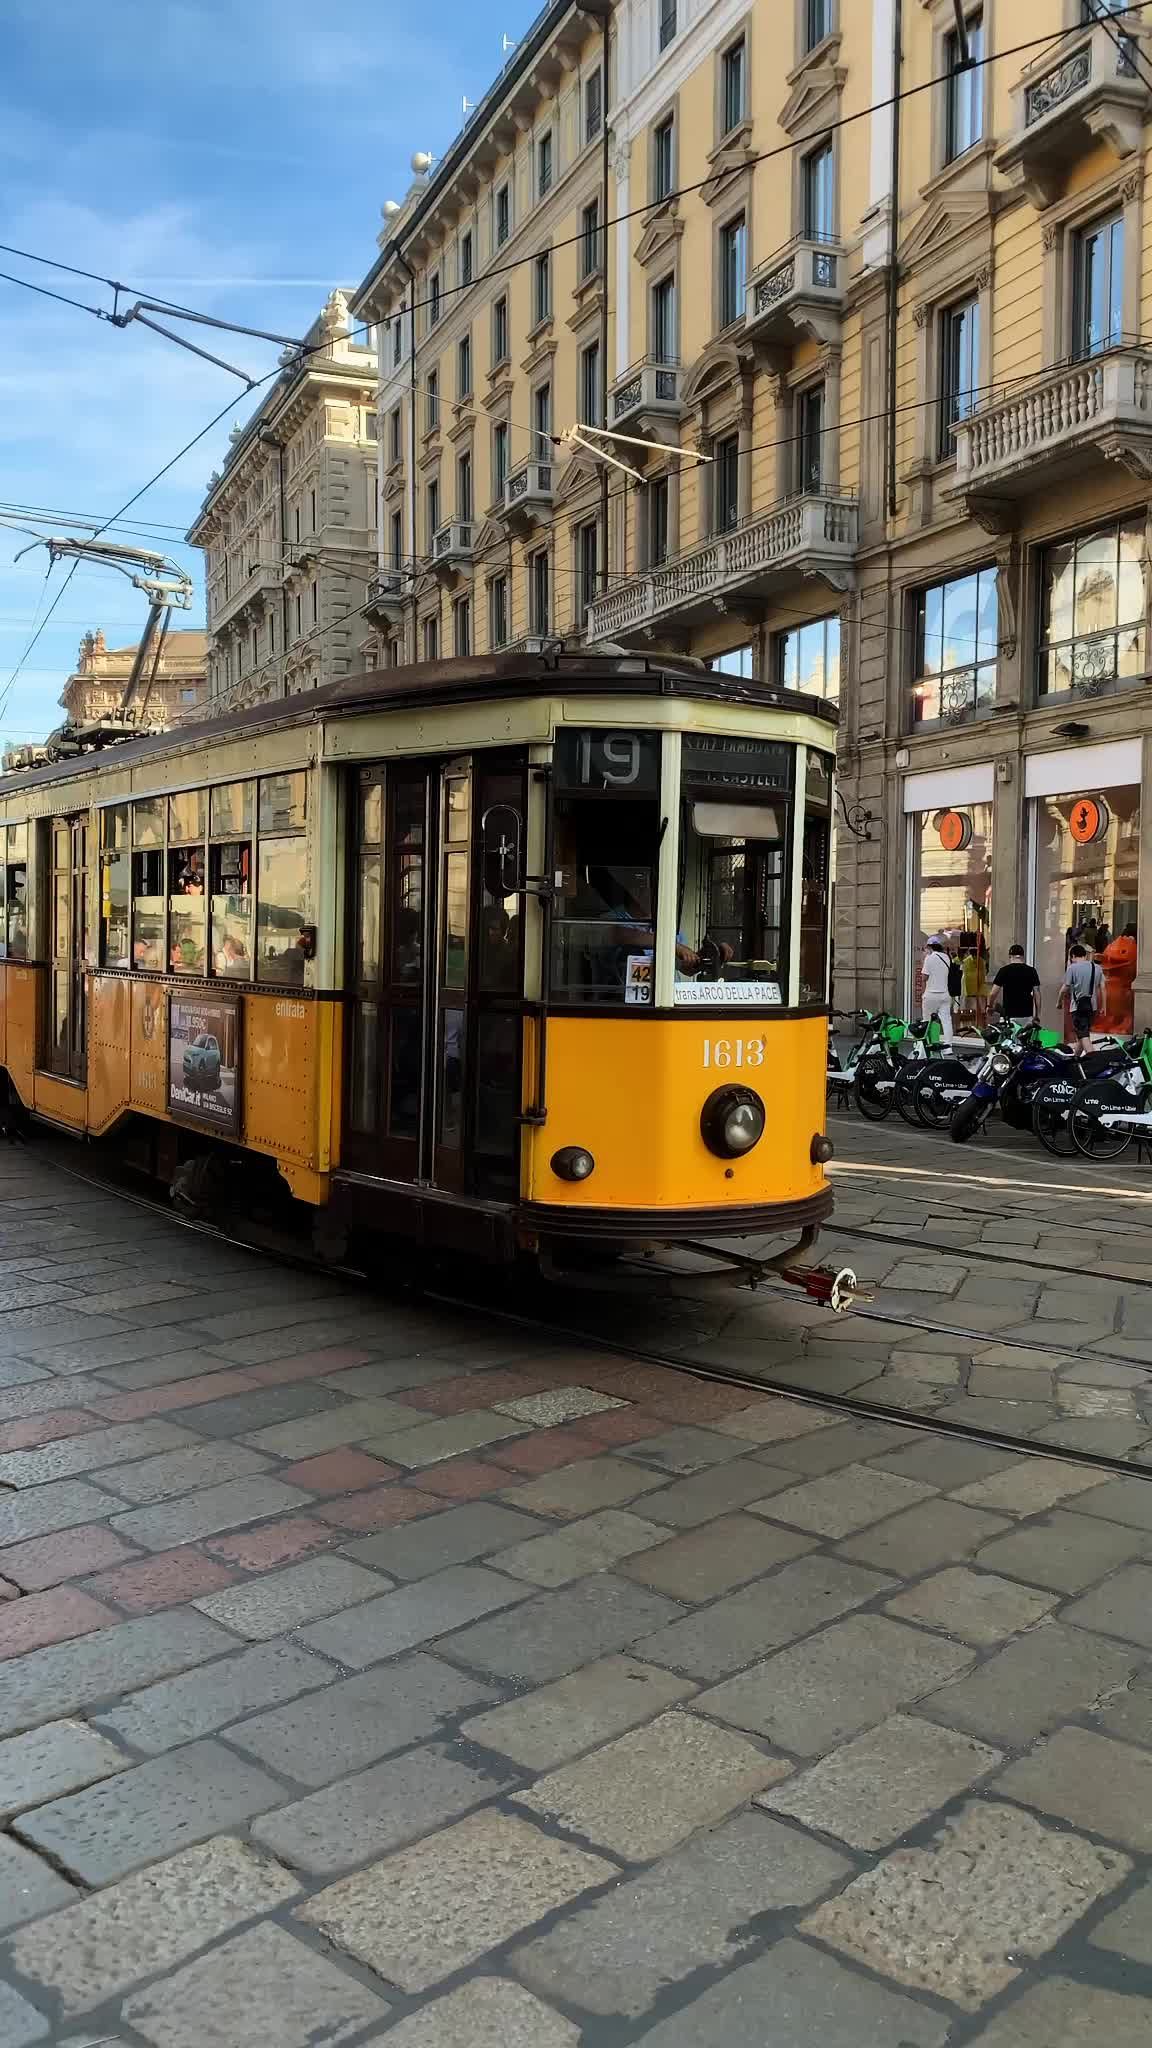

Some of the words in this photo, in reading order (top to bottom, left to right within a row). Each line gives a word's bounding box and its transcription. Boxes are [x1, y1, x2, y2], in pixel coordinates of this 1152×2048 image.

[577, 732, 639, 784] 19
[631, 966, 651, 982] 42
[632, 986, 650, 1001] 19
[725, 986, 754, 1000] DELLA
[754, 986, 779, 1000] PACE
[275, 999, 305, 1019] entrata
[703, 1039, 765, 1068] 1613
